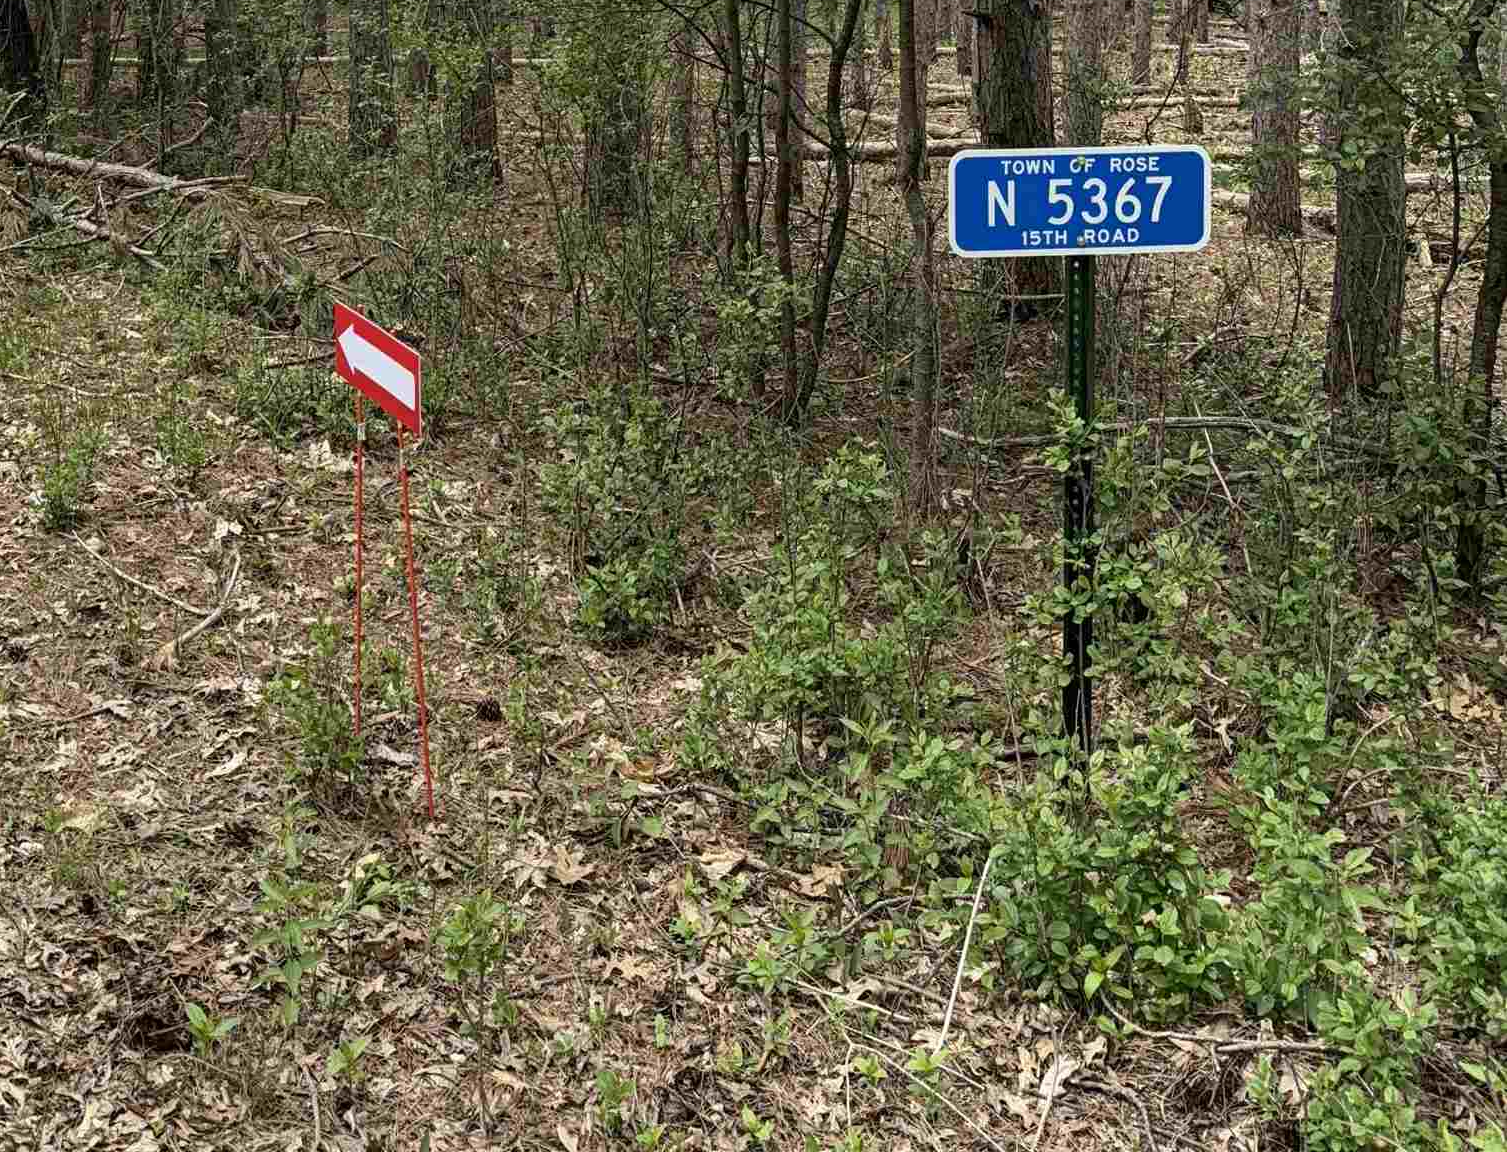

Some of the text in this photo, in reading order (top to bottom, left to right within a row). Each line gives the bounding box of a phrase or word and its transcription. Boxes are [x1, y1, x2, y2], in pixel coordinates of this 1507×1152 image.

[1001, 156, 1160, 175] TOWN OF ROSE
[988, 176, 1173, 227] N 5367
[1021, 228, 1140, 246] 15TH ROAD
